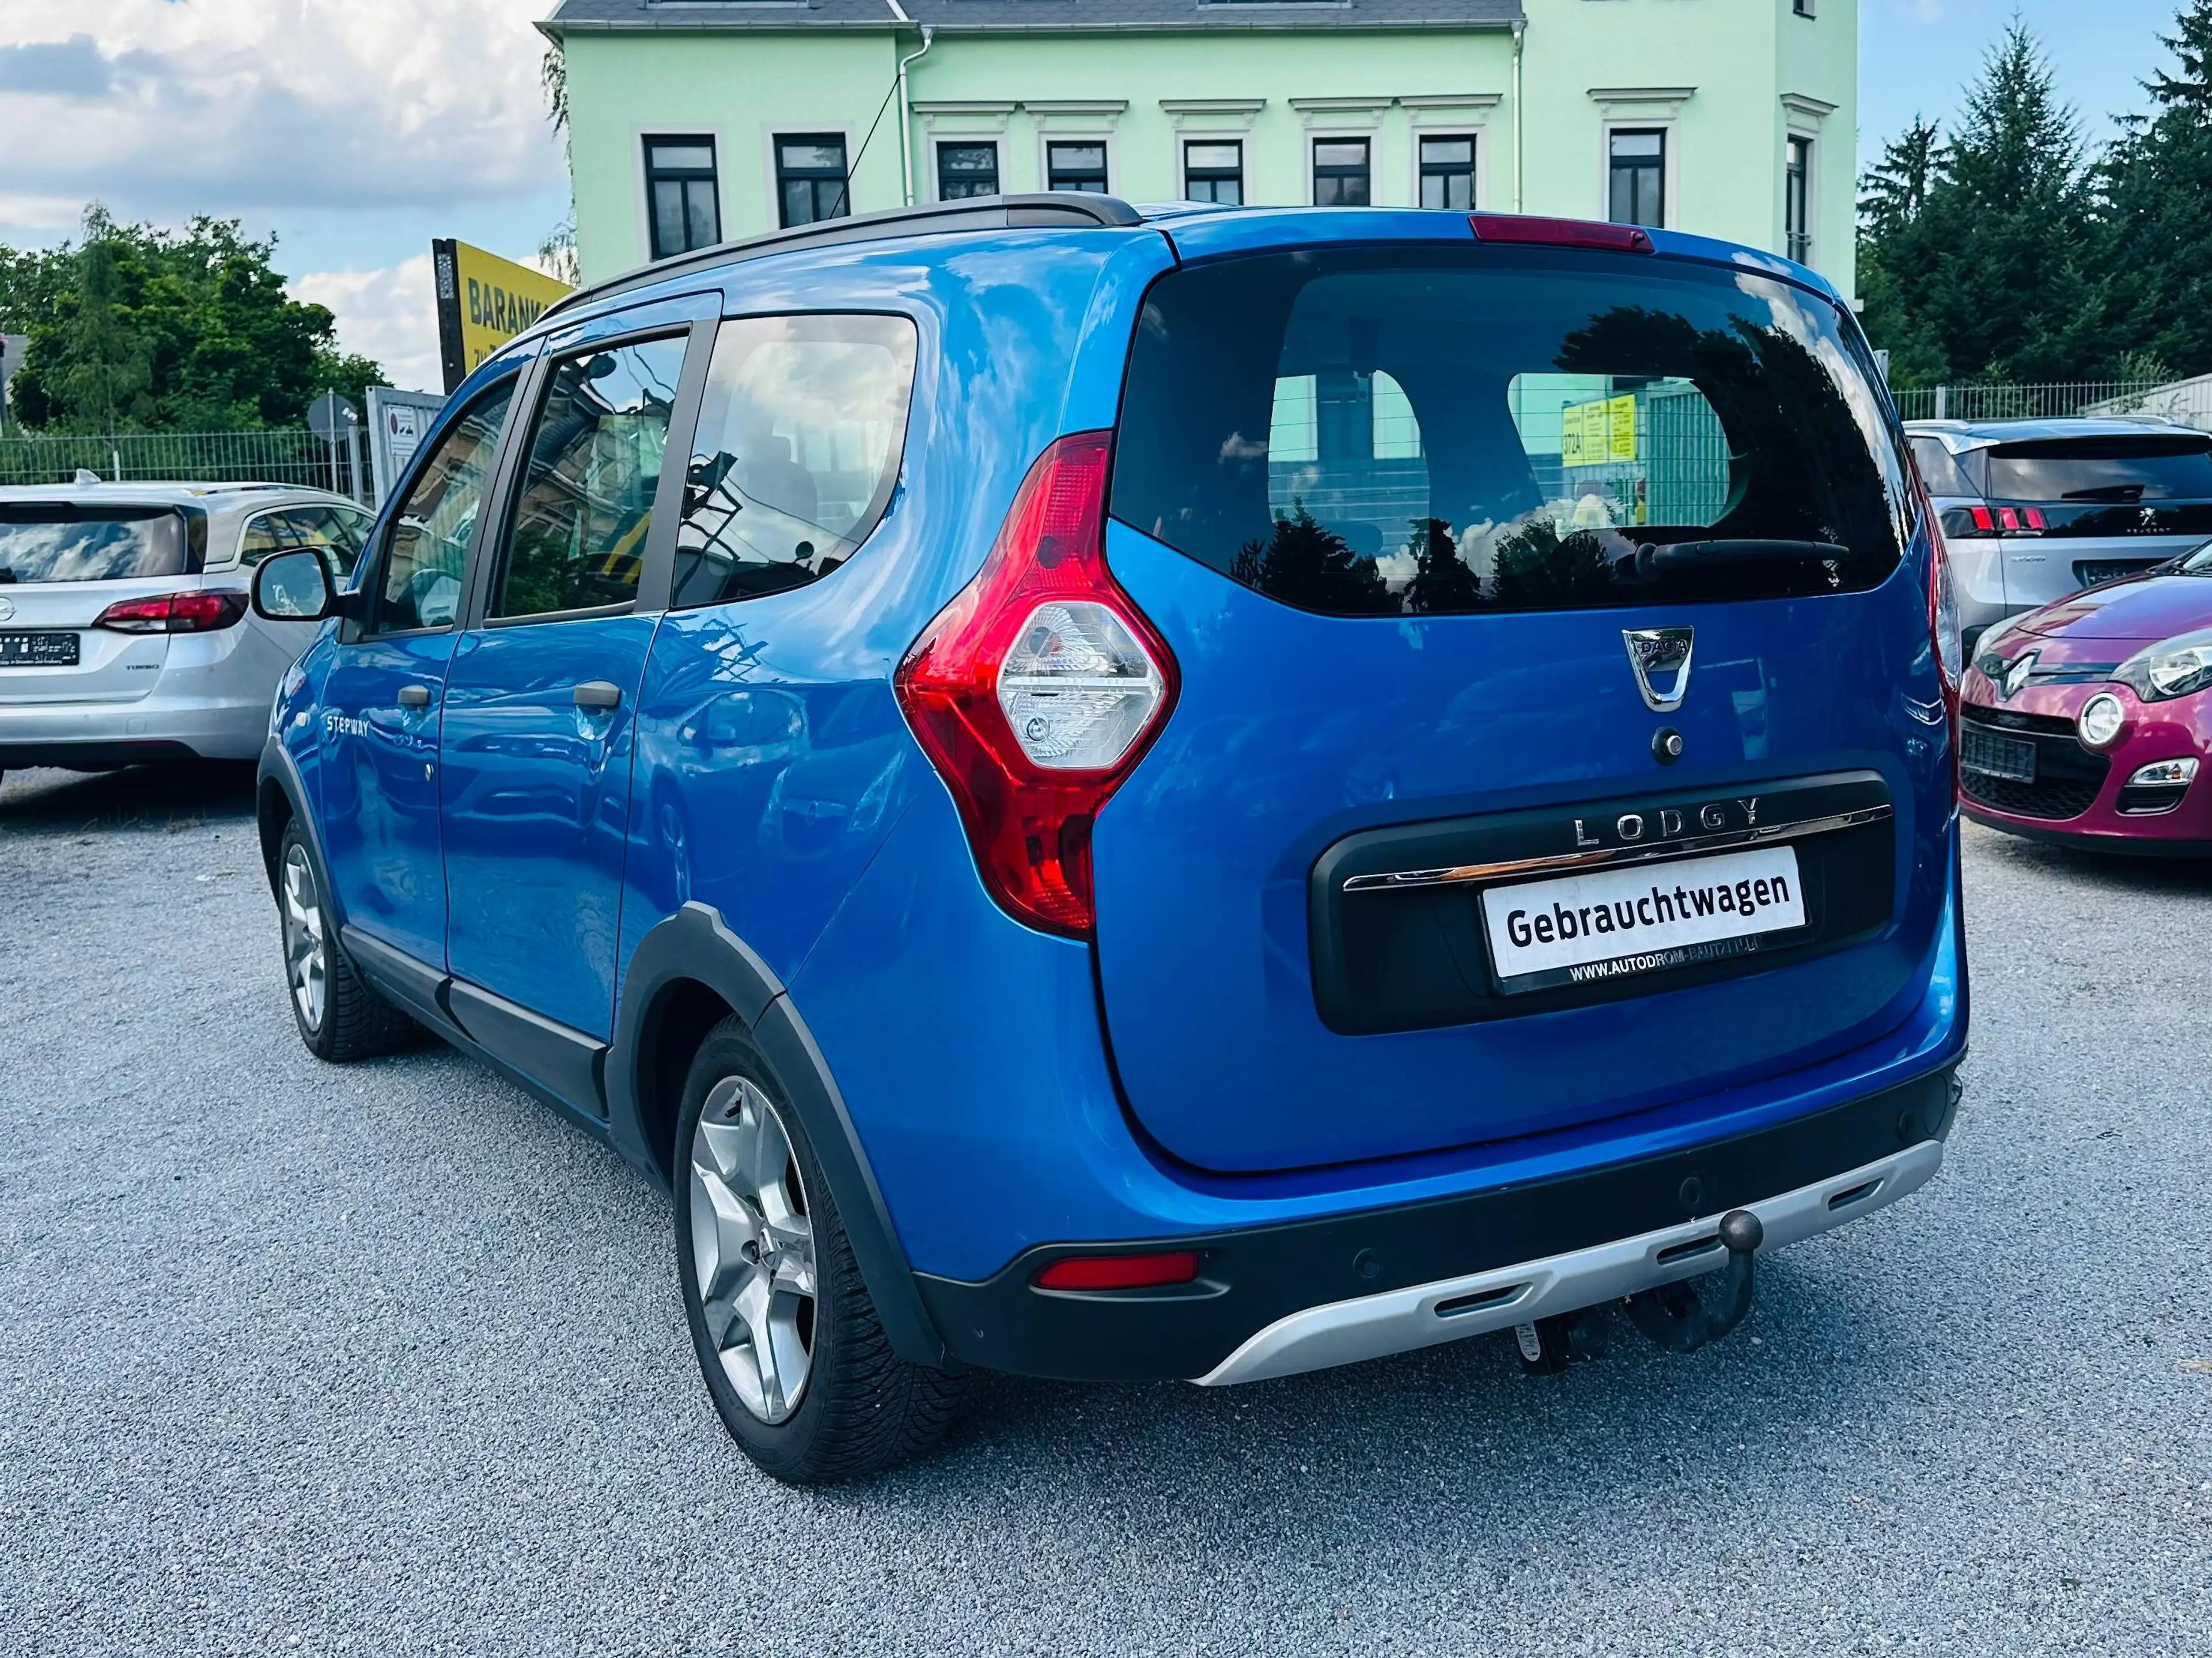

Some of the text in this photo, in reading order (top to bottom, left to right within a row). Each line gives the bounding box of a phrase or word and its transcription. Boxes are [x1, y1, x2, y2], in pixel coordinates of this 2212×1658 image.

[468, 277, 549, 336] BARANK
[1641, 639, 1688, 653] DACIA
[327, 715, 369, 737] STEPWAY
[1574, 797, 1760, 845] LODGY
[1507, 875, 1790, 947] Gebrauchtwagen
